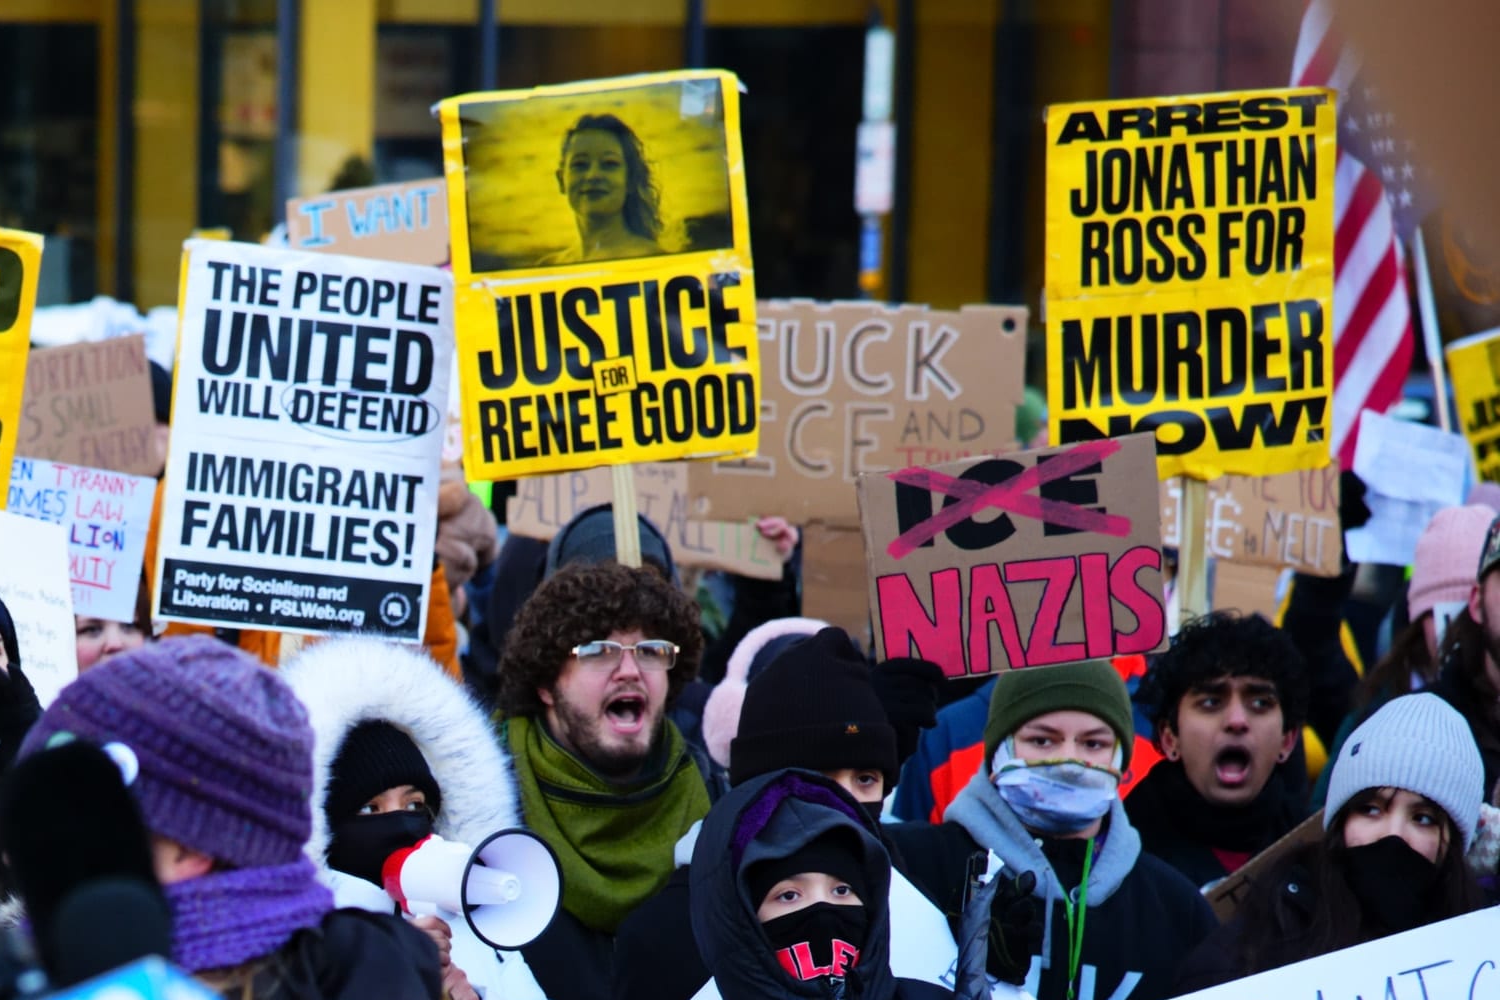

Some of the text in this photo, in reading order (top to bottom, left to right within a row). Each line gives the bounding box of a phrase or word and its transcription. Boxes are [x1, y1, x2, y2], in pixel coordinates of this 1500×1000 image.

[1055, 95, 1328, 145] ARREST
[1070, 135, 1318, 217] JONATHAN
[299, 186, 438, 248] I WANT
[1080, 207, 1306, 287] ROSS FOR
[207, 261, 442, 325] THE PEOPLE
[201, 308, 434, 396] UNITED
[478, 274, 748, 390] JUSTICE
[759, 318, 963, 401] UCK
[1061, 298, 1325, 411] MURDER
[197, 378, 430, 438] WILL DEFEND
[600, 365, 629, 388] FOR
[479, 373, 756, 464] RENEE GOOD
[900, 407, 986, 444] AND
[1058, 395, 1328, 456] NOW!
[8, 486, 68, 518] OMES
[51, 462, 139, 497] TYRANNY
[186, 451, 424, 516] IMMIGRANT
[894, 450, 1109, 552] ICE
[180, 499, 416, 568] FAMILIES!
[172, 589, 366, 626] Liberation PSLWeb.org
[174, 568, 348, 602] Party for Socialism and
[876, 545, 1166, 679] NAZIS
